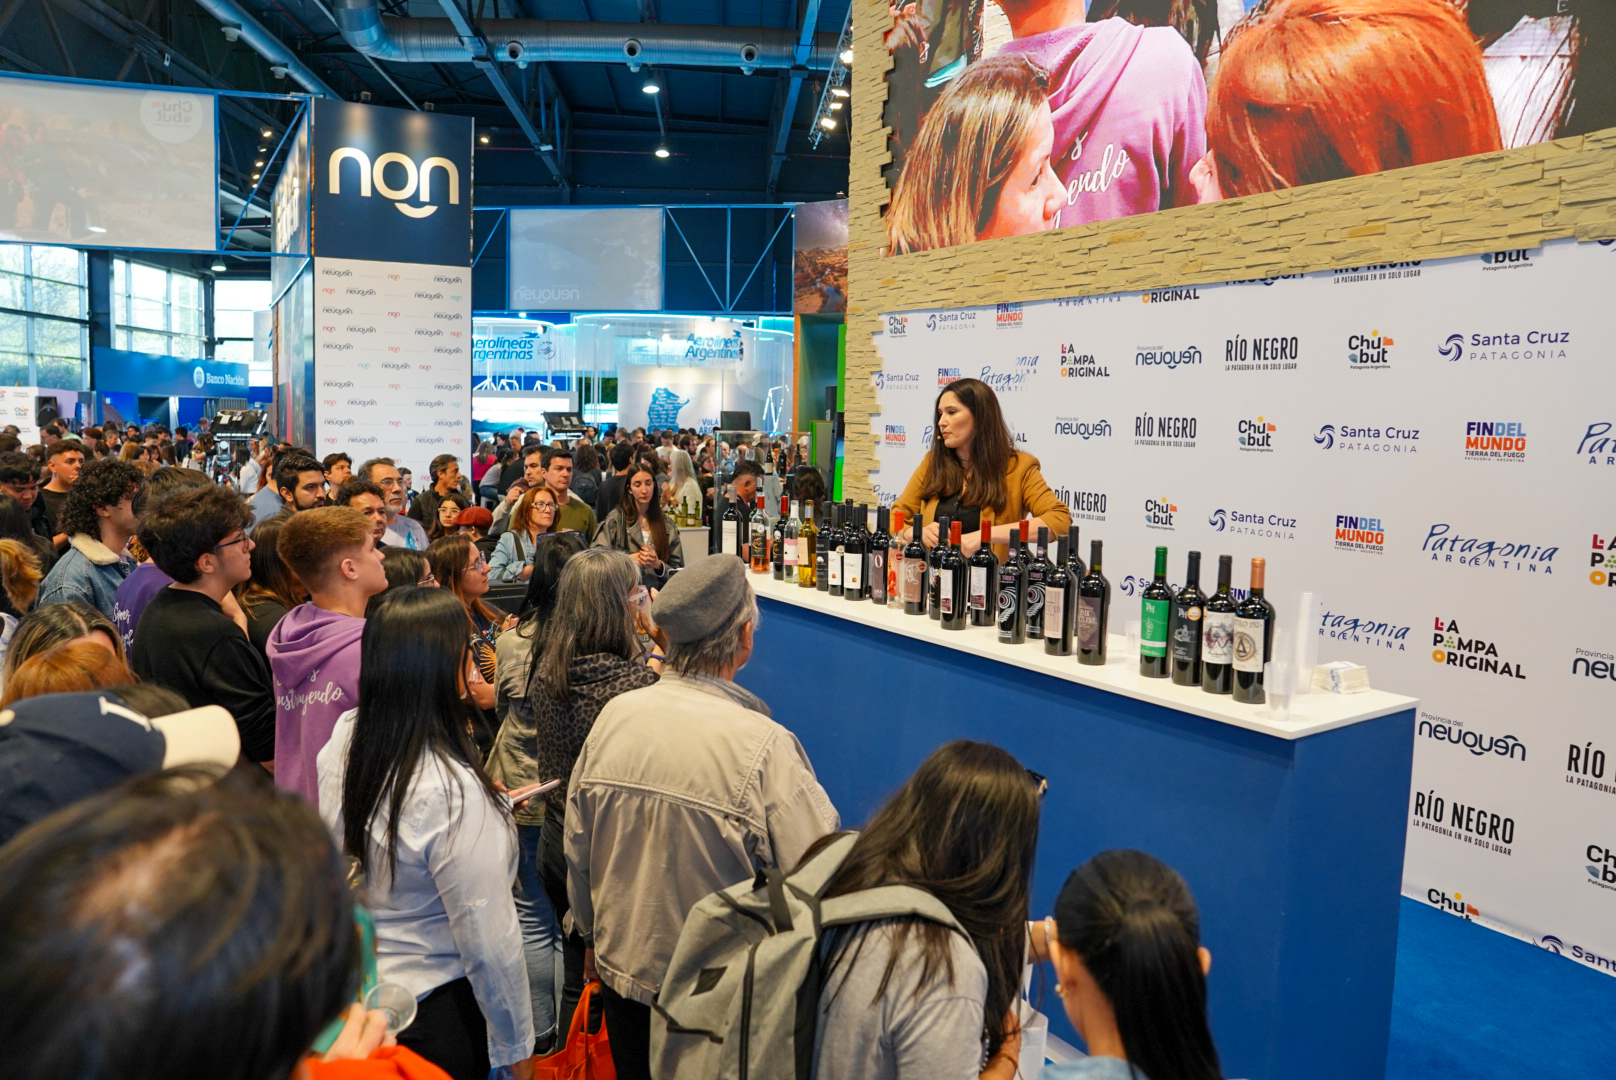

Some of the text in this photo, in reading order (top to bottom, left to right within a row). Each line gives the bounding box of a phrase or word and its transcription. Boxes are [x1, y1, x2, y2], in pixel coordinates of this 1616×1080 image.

[1341, 275, 1369, 284] PATAGONIA
[1388, 271, 1402, 279] SOLO
[1404, 270, 1421, 278] LUGAR
[1142, 288, 1200, 304] ORIGINAL
[939, 312, 976, 322] Santa Cruz
[996, 312, 1023, 322] MUNDO
[1348, 335, 1381, 350] Chu
[1470, 331, 1570, 347] Santa Cruz
[1061, 343, 1075, 354] LA
[1226, 334, 1298, 361] RÍO NEGRO
[1470, 349, 1566, 361] PATAGONIA
[473, 349, 533, 362] rgentinas
[1359, 348, 1388, 363] but
[206, 373, 244, 386] Banco Nación
[905, 373, 919, 381] Cruz
[1060, 367, 1110, 377] ORIGINAL
[1135, 412, 1197, 439] RÍO NEGRO
[1238, 419, 1266, 434] Chu
[1340, 425, 1419, 440] Santa Cruz
[885, 434, 906, 442] MUNDO
[1248, 432, 1271, 447] but
[1465, 436, 1526, 451] MUNDO
[1339, 442, 1417, 453] PATAGONIA
[1074, 491, 1107, 513] NEGRO
[1145, 499, 1168, 513] Chu
[1153, 511, 1173, 526] but
[1230, 511, 1297, 528] Santa Cruz
[1230, 526, 1294, 540] PATAGONIA
[1335, 528, 1384, 545] MUNDO
[1422, 524, 1559, 567] Patagonia
[1432, 552, 1552, 574] ARGENTINA
[1434, 616, 1459, 634] LA
[1319, 628, 1405, 651] RGENTINA
[1575, 648, 1614, 660] Provincia
[1432, 649, 1526, 680] ORIGINAL
[1421, 712, 1451, 725] Provincia
[1567, 741, 1605, 778] RÍO
[1566, 775, 1616, 795] LA PATAGONIA
[1414, 790, 1514, 844] RÍO NEGRO
[1413, 819, 1511, 856] LA PATAGONIA EN UN SOLO LUGAR
[1427, 888, 1465, 914] Chu
